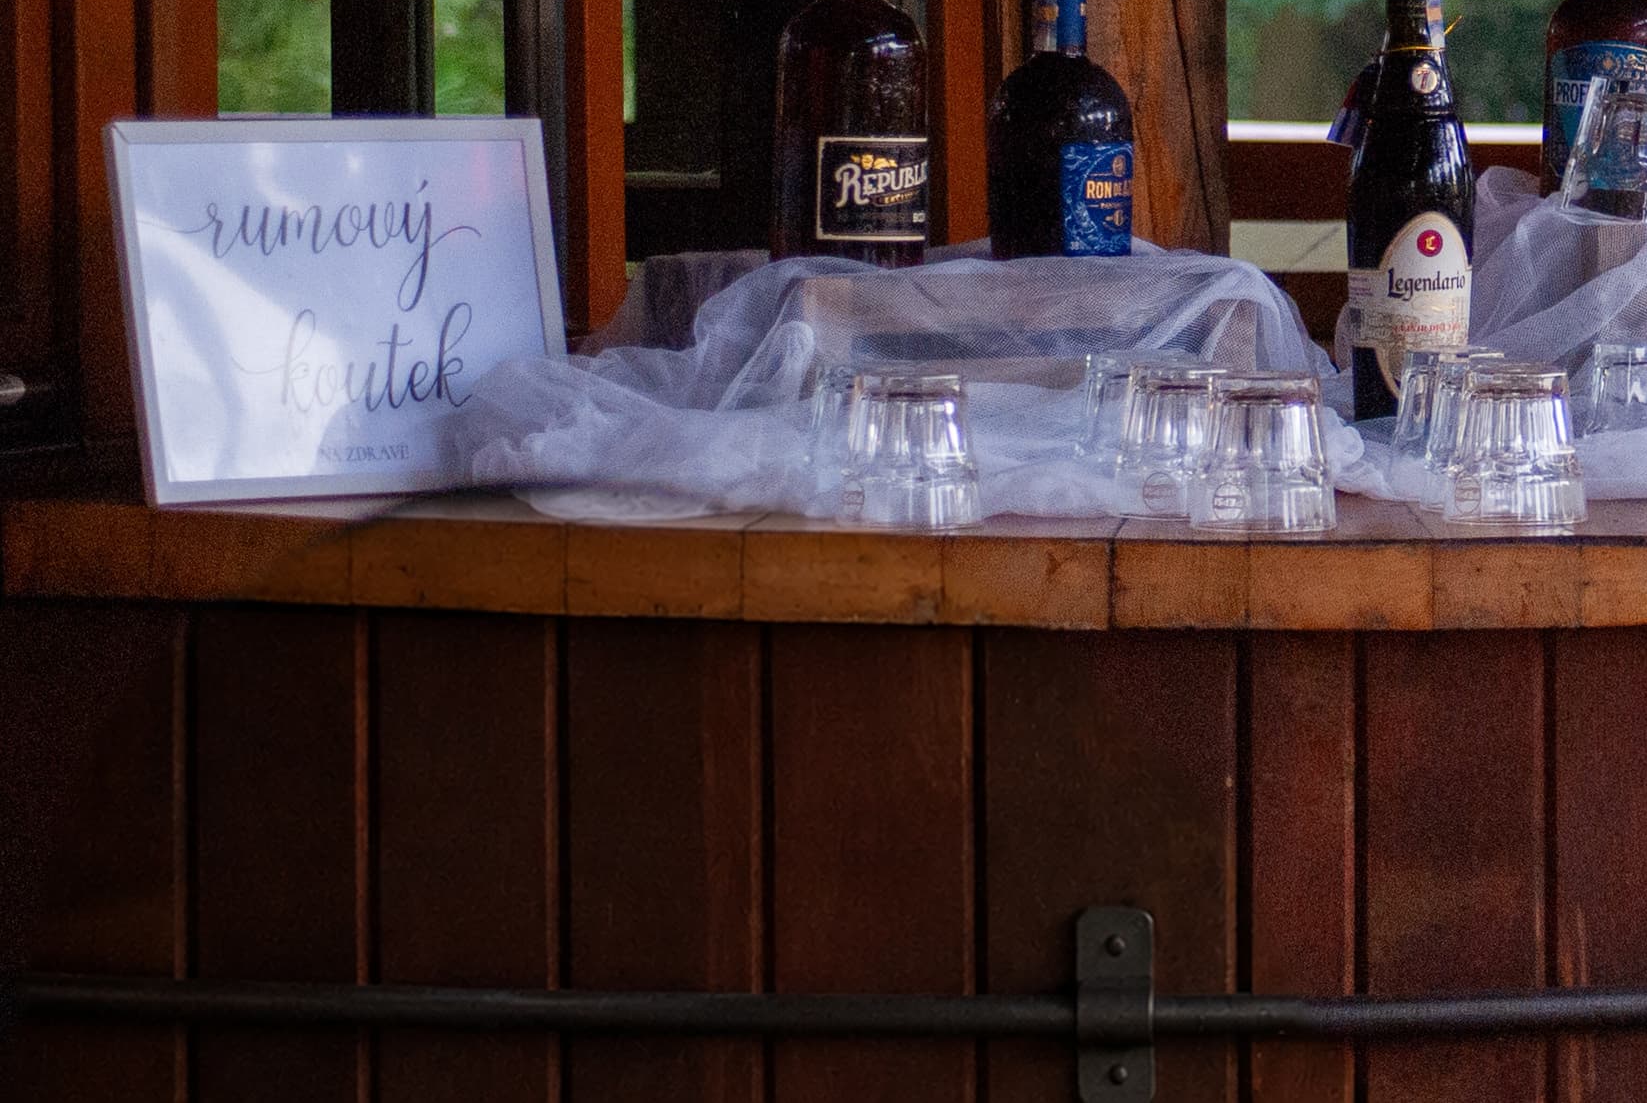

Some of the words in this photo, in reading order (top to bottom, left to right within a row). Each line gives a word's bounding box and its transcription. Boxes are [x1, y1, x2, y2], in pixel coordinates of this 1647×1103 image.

[1086, 180, 1112, 199] RON
[137, 179, 482, 312] rumový
[1387, 267, 1465, 302] Legendario
[232, 301, 474, 414] koutek
